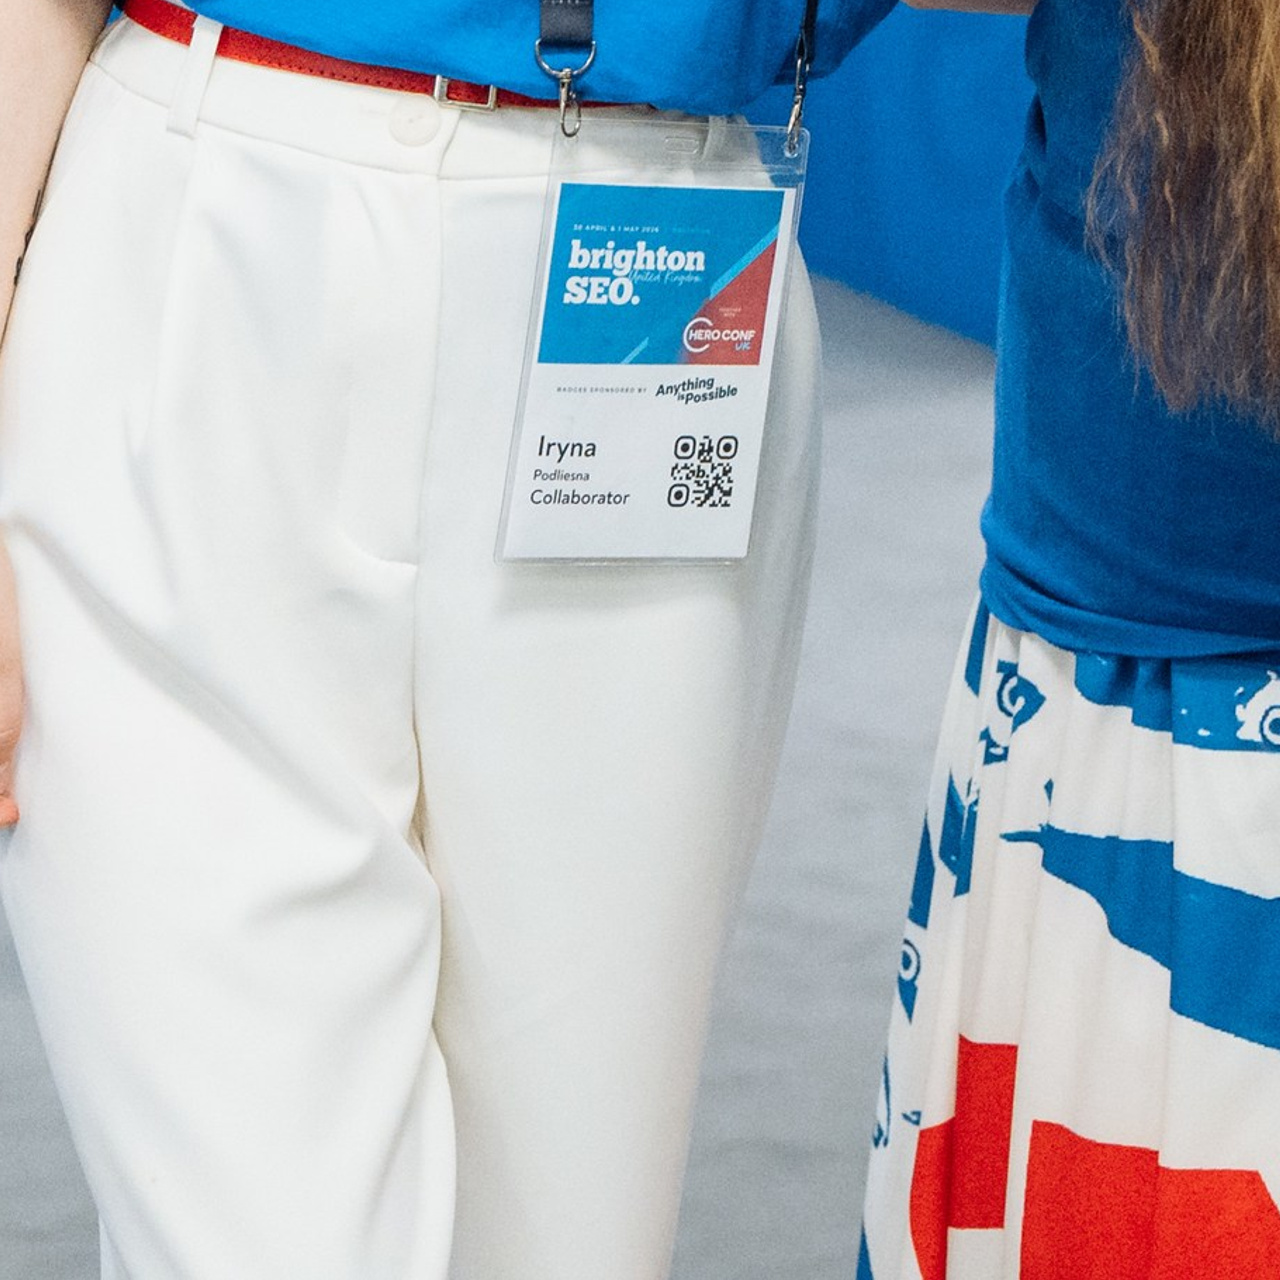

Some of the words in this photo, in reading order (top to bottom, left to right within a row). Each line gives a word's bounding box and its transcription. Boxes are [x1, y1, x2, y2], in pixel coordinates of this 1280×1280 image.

[568, 238, 706, 277] brighton
[688, 329, 720, 341] HERO
[721, 329, 757, 341] CONF
[655, 377, 716, 397] Anything
[537, 435, 597, 464] Iryna
[533, 469, 590, 482] Podliesna
[530, 489, 630, 505] Collaborator
